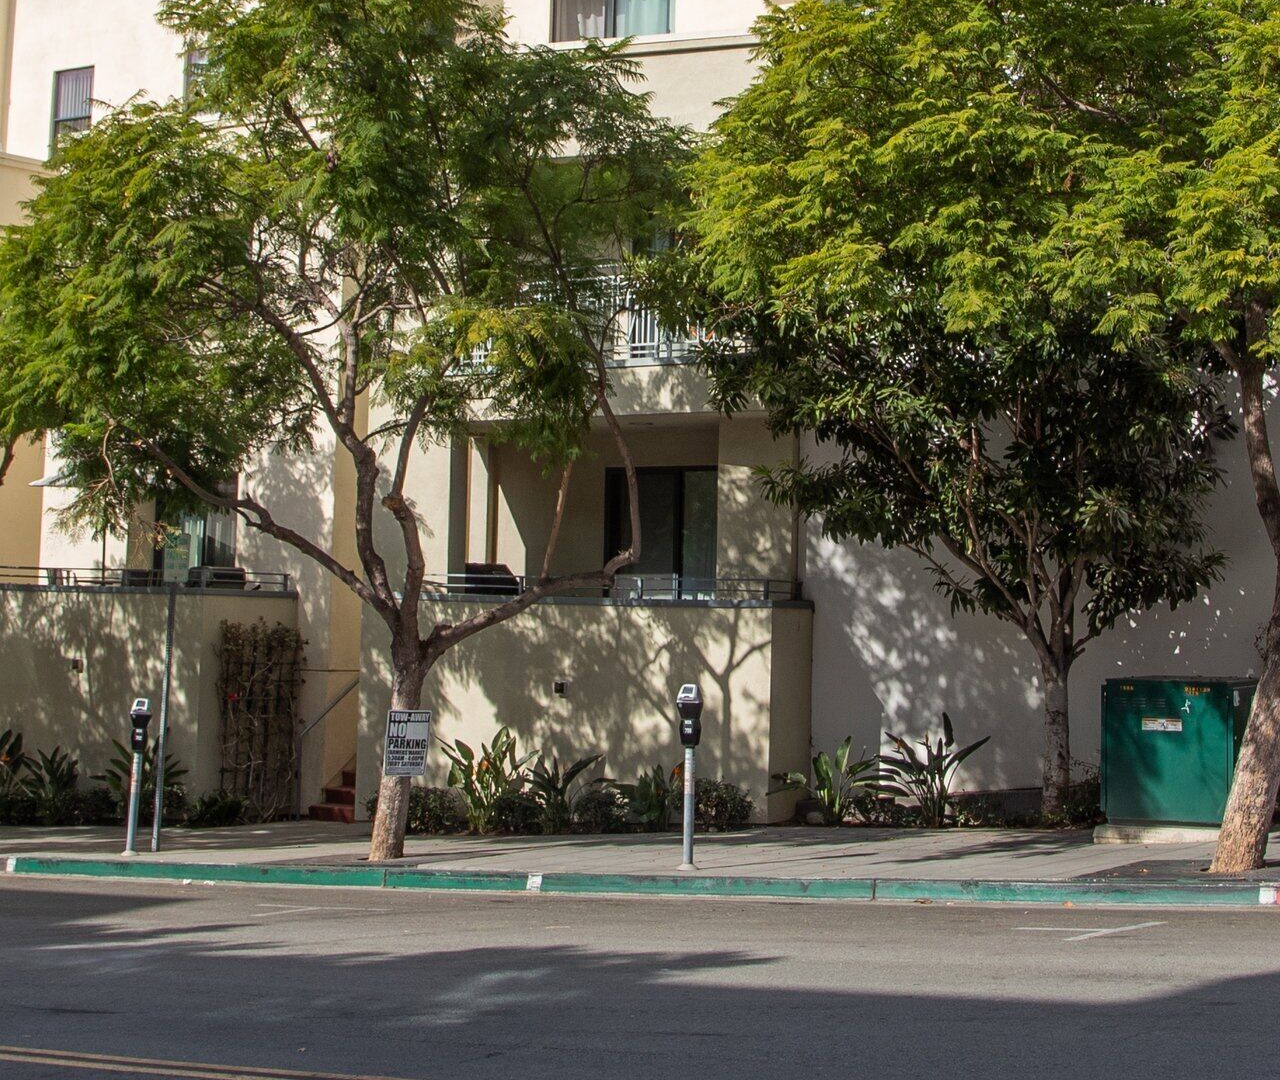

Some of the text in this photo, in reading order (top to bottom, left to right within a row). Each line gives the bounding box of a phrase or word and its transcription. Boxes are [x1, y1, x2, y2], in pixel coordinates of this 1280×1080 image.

[391, 712, 430, 721] TOW-AWAY
[389, 722, 407, 737] NO
[388, 738, 427, 749] PARKING
